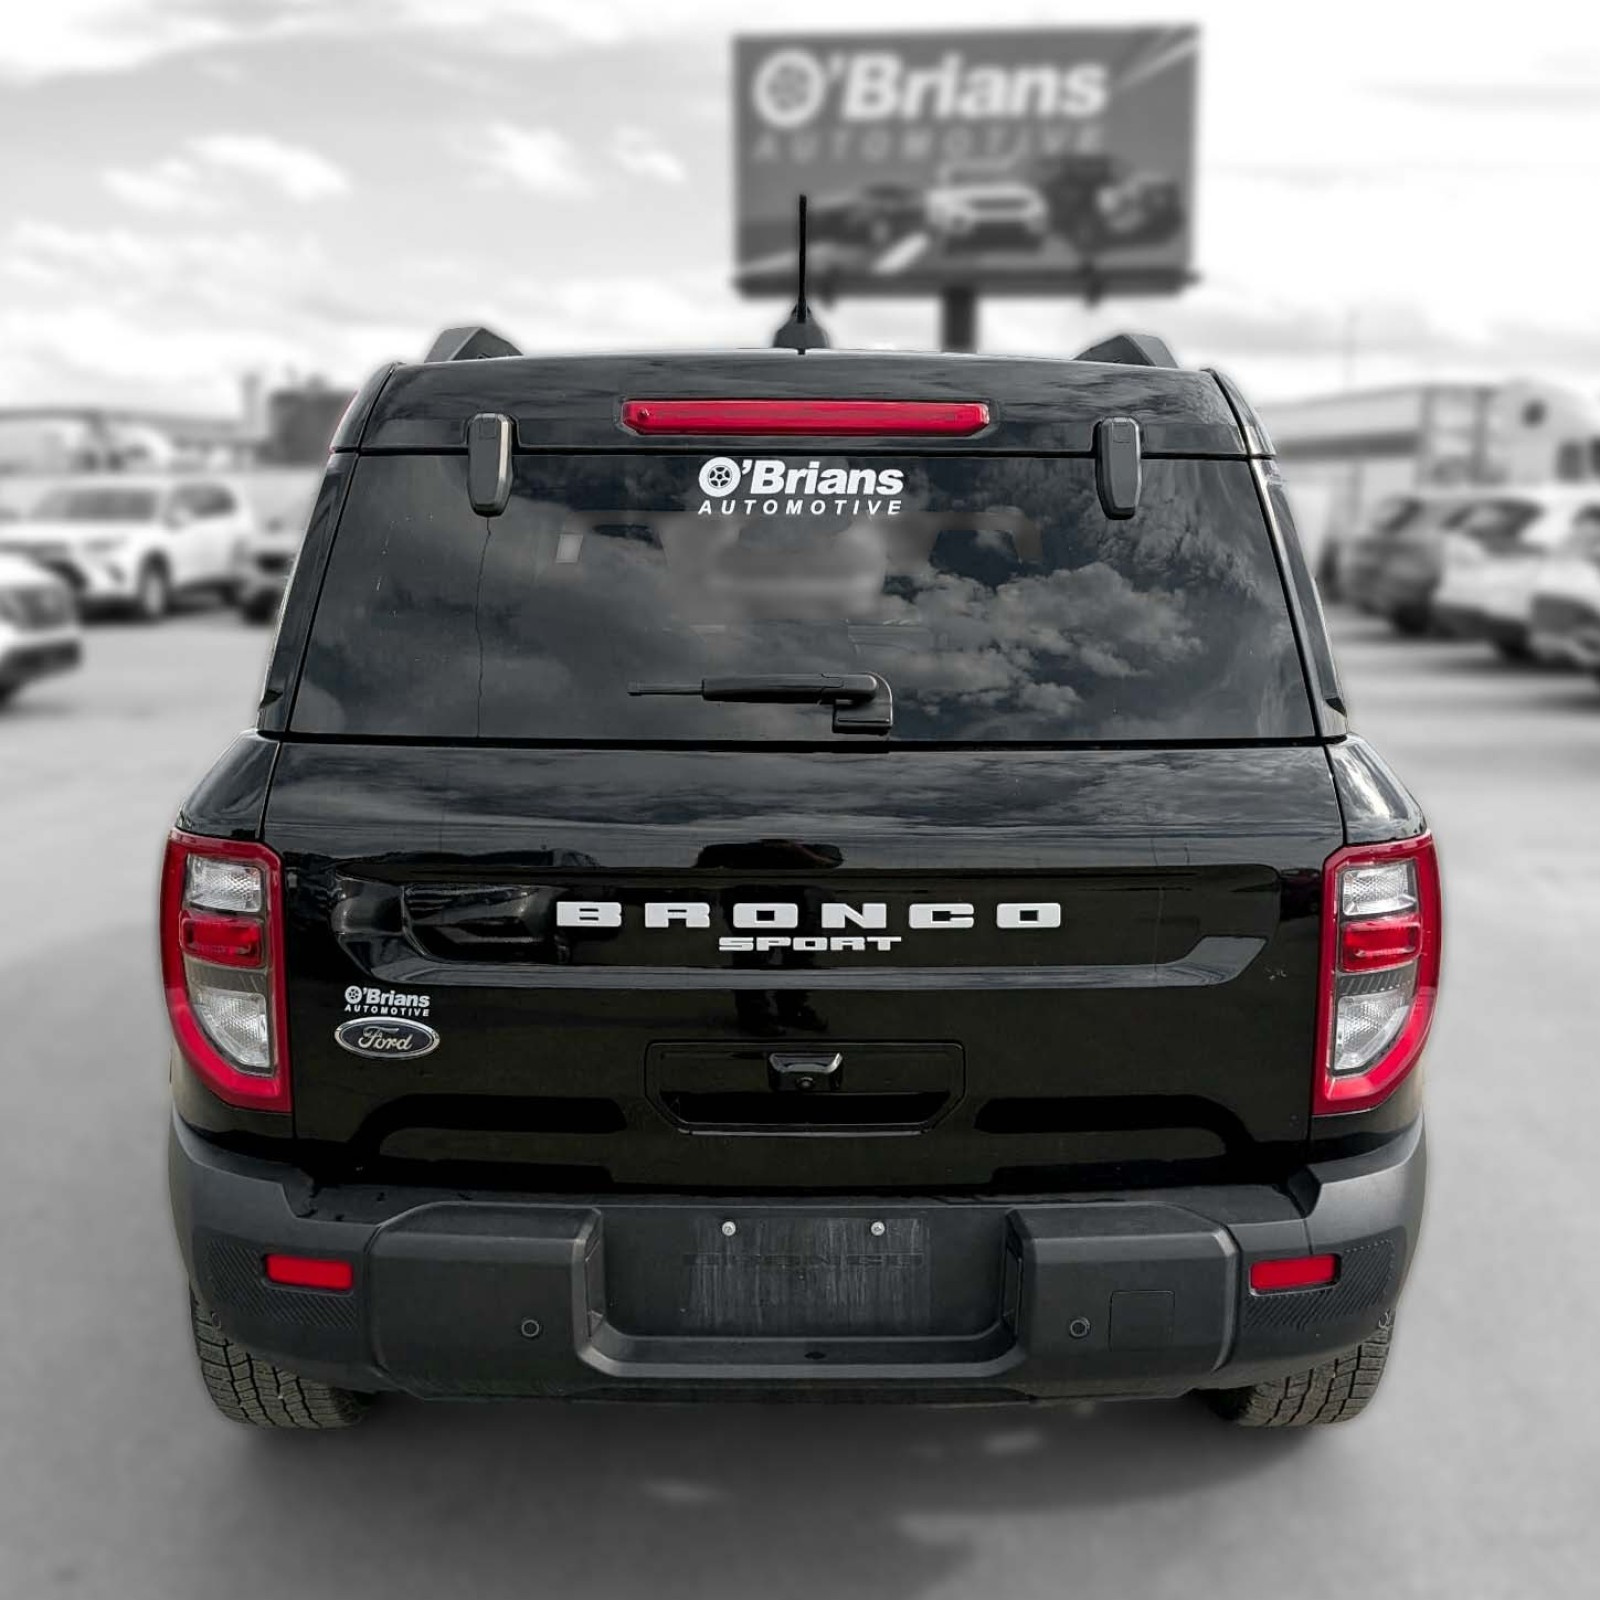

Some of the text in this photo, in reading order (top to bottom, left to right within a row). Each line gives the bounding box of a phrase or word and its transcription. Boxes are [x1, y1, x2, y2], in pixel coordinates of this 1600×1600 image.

[753, 49, 1109, 127] O'Brians
[699, 456, 904, 497] O'Brians
[698, 500, 902, 515] AUTOMOTIVE
[556, 901, 1061, 929] BRONCO
[718, 936, 902, 951] SPORT
[344, 985, 430, 1007] O'Brians
[344, 1004, 430, 1016] AUTOMOTIVE
[358, 1026, 413, 1050] Ford
